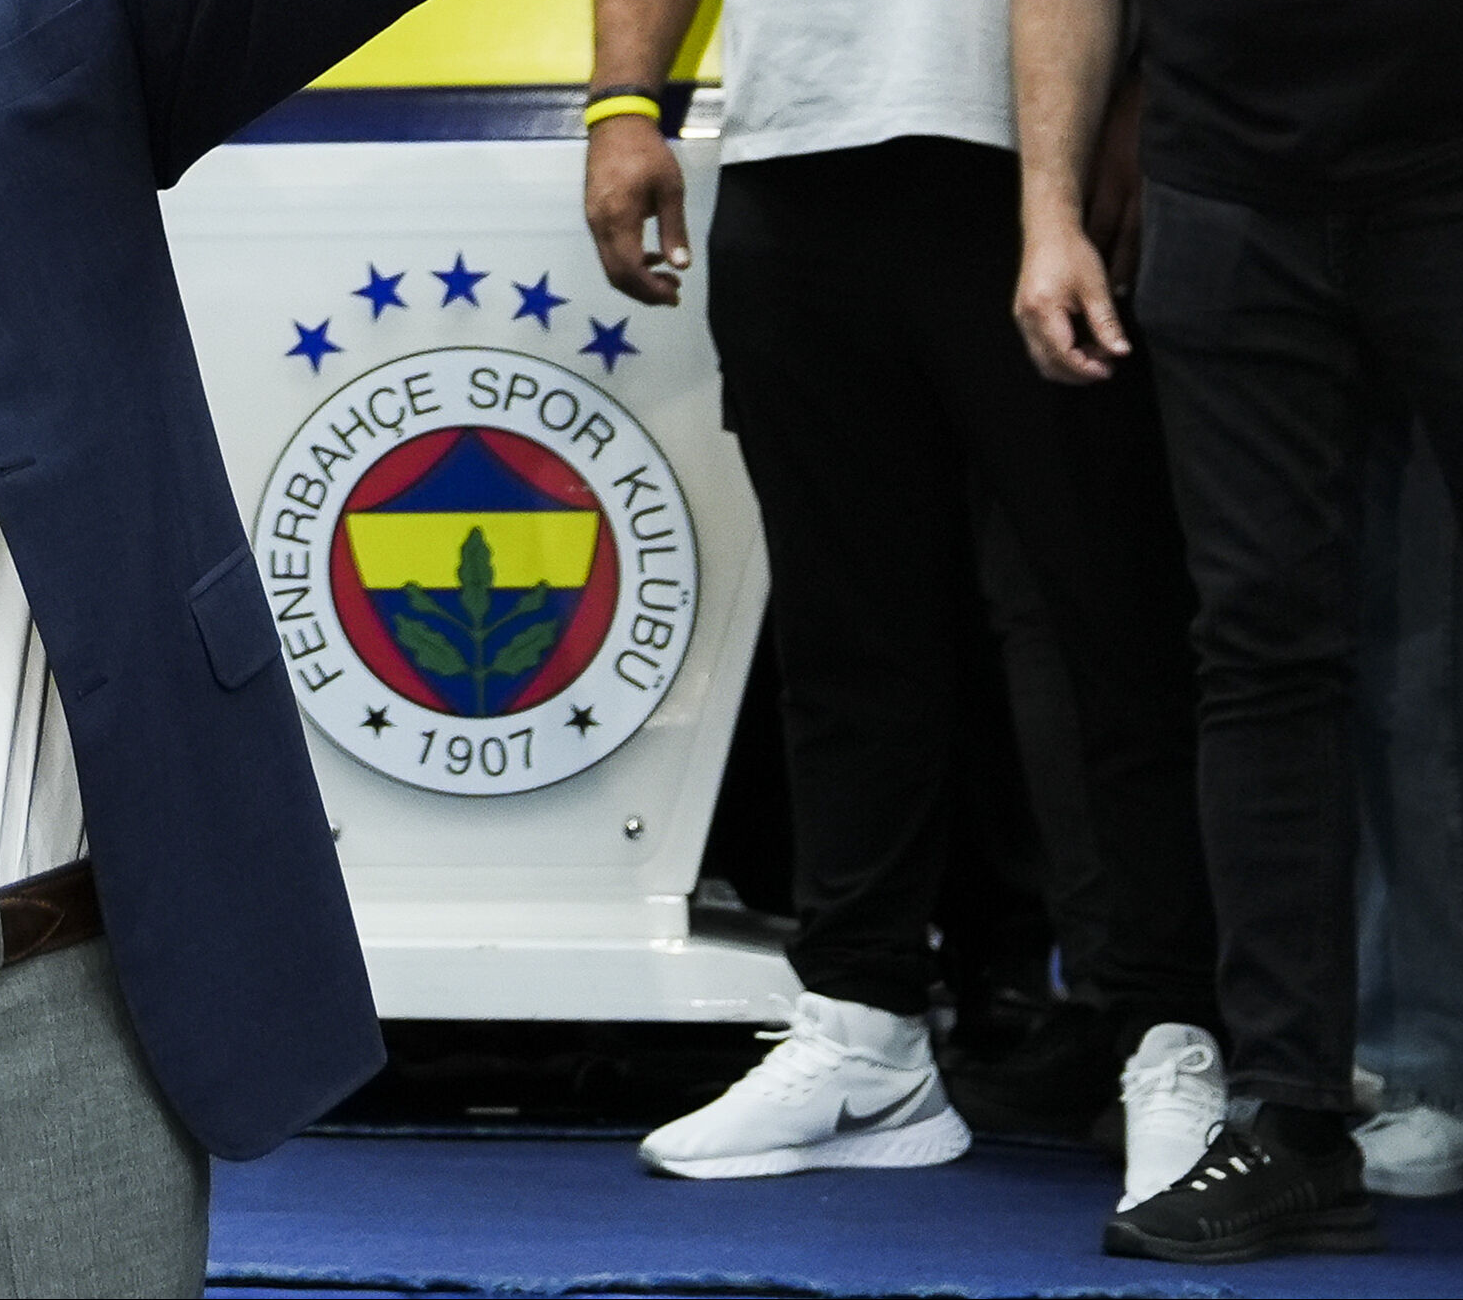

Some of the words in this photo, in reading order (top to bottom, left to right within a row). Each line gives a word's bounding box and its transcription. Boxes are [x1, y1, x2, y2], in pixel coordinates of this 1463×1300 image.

[269, 371, 443, 695] FENERBAHÇE
[467, 366, 617, 463] SPOR
[612, 464, 692, 693] KULÜBÜ
[417, 727, 537, 777] 1907
